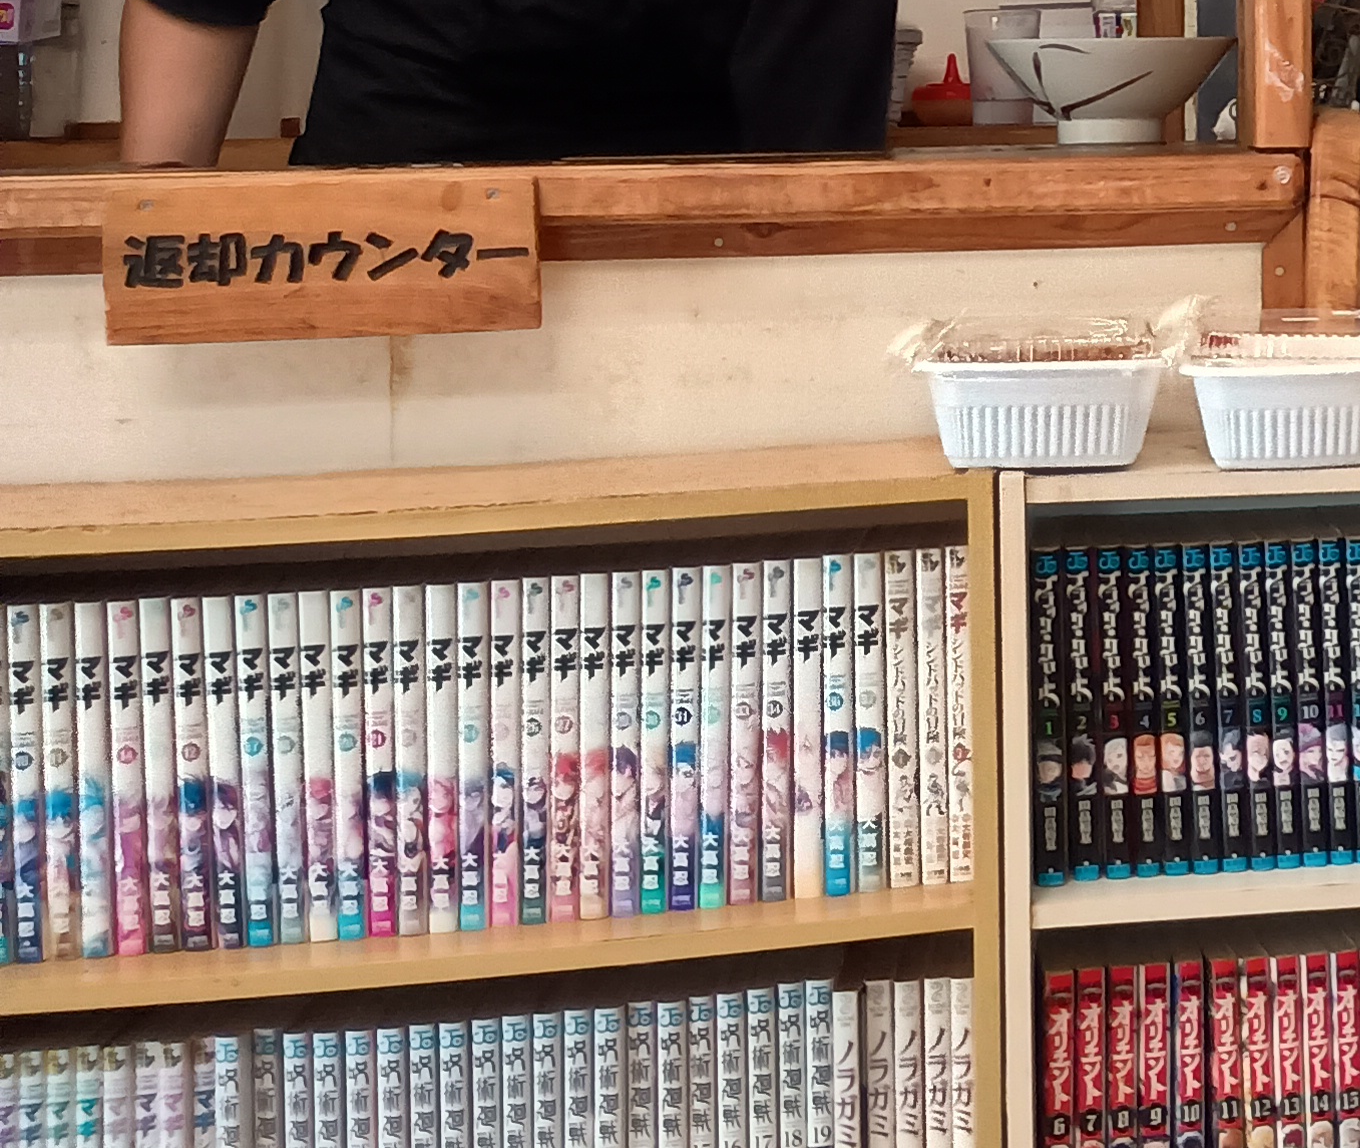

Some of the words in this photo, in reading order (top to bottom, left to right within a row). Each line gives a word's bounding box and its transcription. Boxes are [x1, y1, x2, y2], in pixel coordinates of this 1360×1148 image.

[123, 228, 530, 289] 返却カウンター
[524, 630, 547, 683] マギ
[642, 622, 665, 675] マギ
[764, 613, 788, 666] マギ
[856, 605, 880, 655] マギ
[9, 660, 35, 714] マギ
[44, 657, 68, 712] マギ
[112, 655, 138, 710] マギ
[208, 651, 234, 705] マギ
[271, 647, 297, 700] マギ
[336, 644, 360, 697] マギ
[430, 638, 453, 692] マギ
[1050, 1007, 1072, 1110] オリエント
[1143, 998, 1167, 1101] オリエント
[1178, 995, 1202, 1097] オリエント
[1247, 991, 1272, 1093] オリエント
[1277, 988, 1300, 1092] オリエント
[1304, 986, 1333, 1088] オリエント
[870, 1030, 890, 1138] ノラガミ
[900, 1029, 920, 1136] ノラガミ
[928, 1027, 948, 1135] ノラガミ
[952, 1027, 973, 1135] ノラガミ
[1254, 1097, 1272, 1117] 12
[1283, 1096, 1300, 1115] 13
[1312, 1094, 1329, 1112] 14
[784, 1129, 803, 1147] 18
[813, 1125, 832, 1142] 19
[1053, 1117, 1065, 1135] 6
[1150, 1107, 1162, 1125] 9
[1183, 1103, 1200, 1123] 10
[754, 1133, 774, 1148] 17
